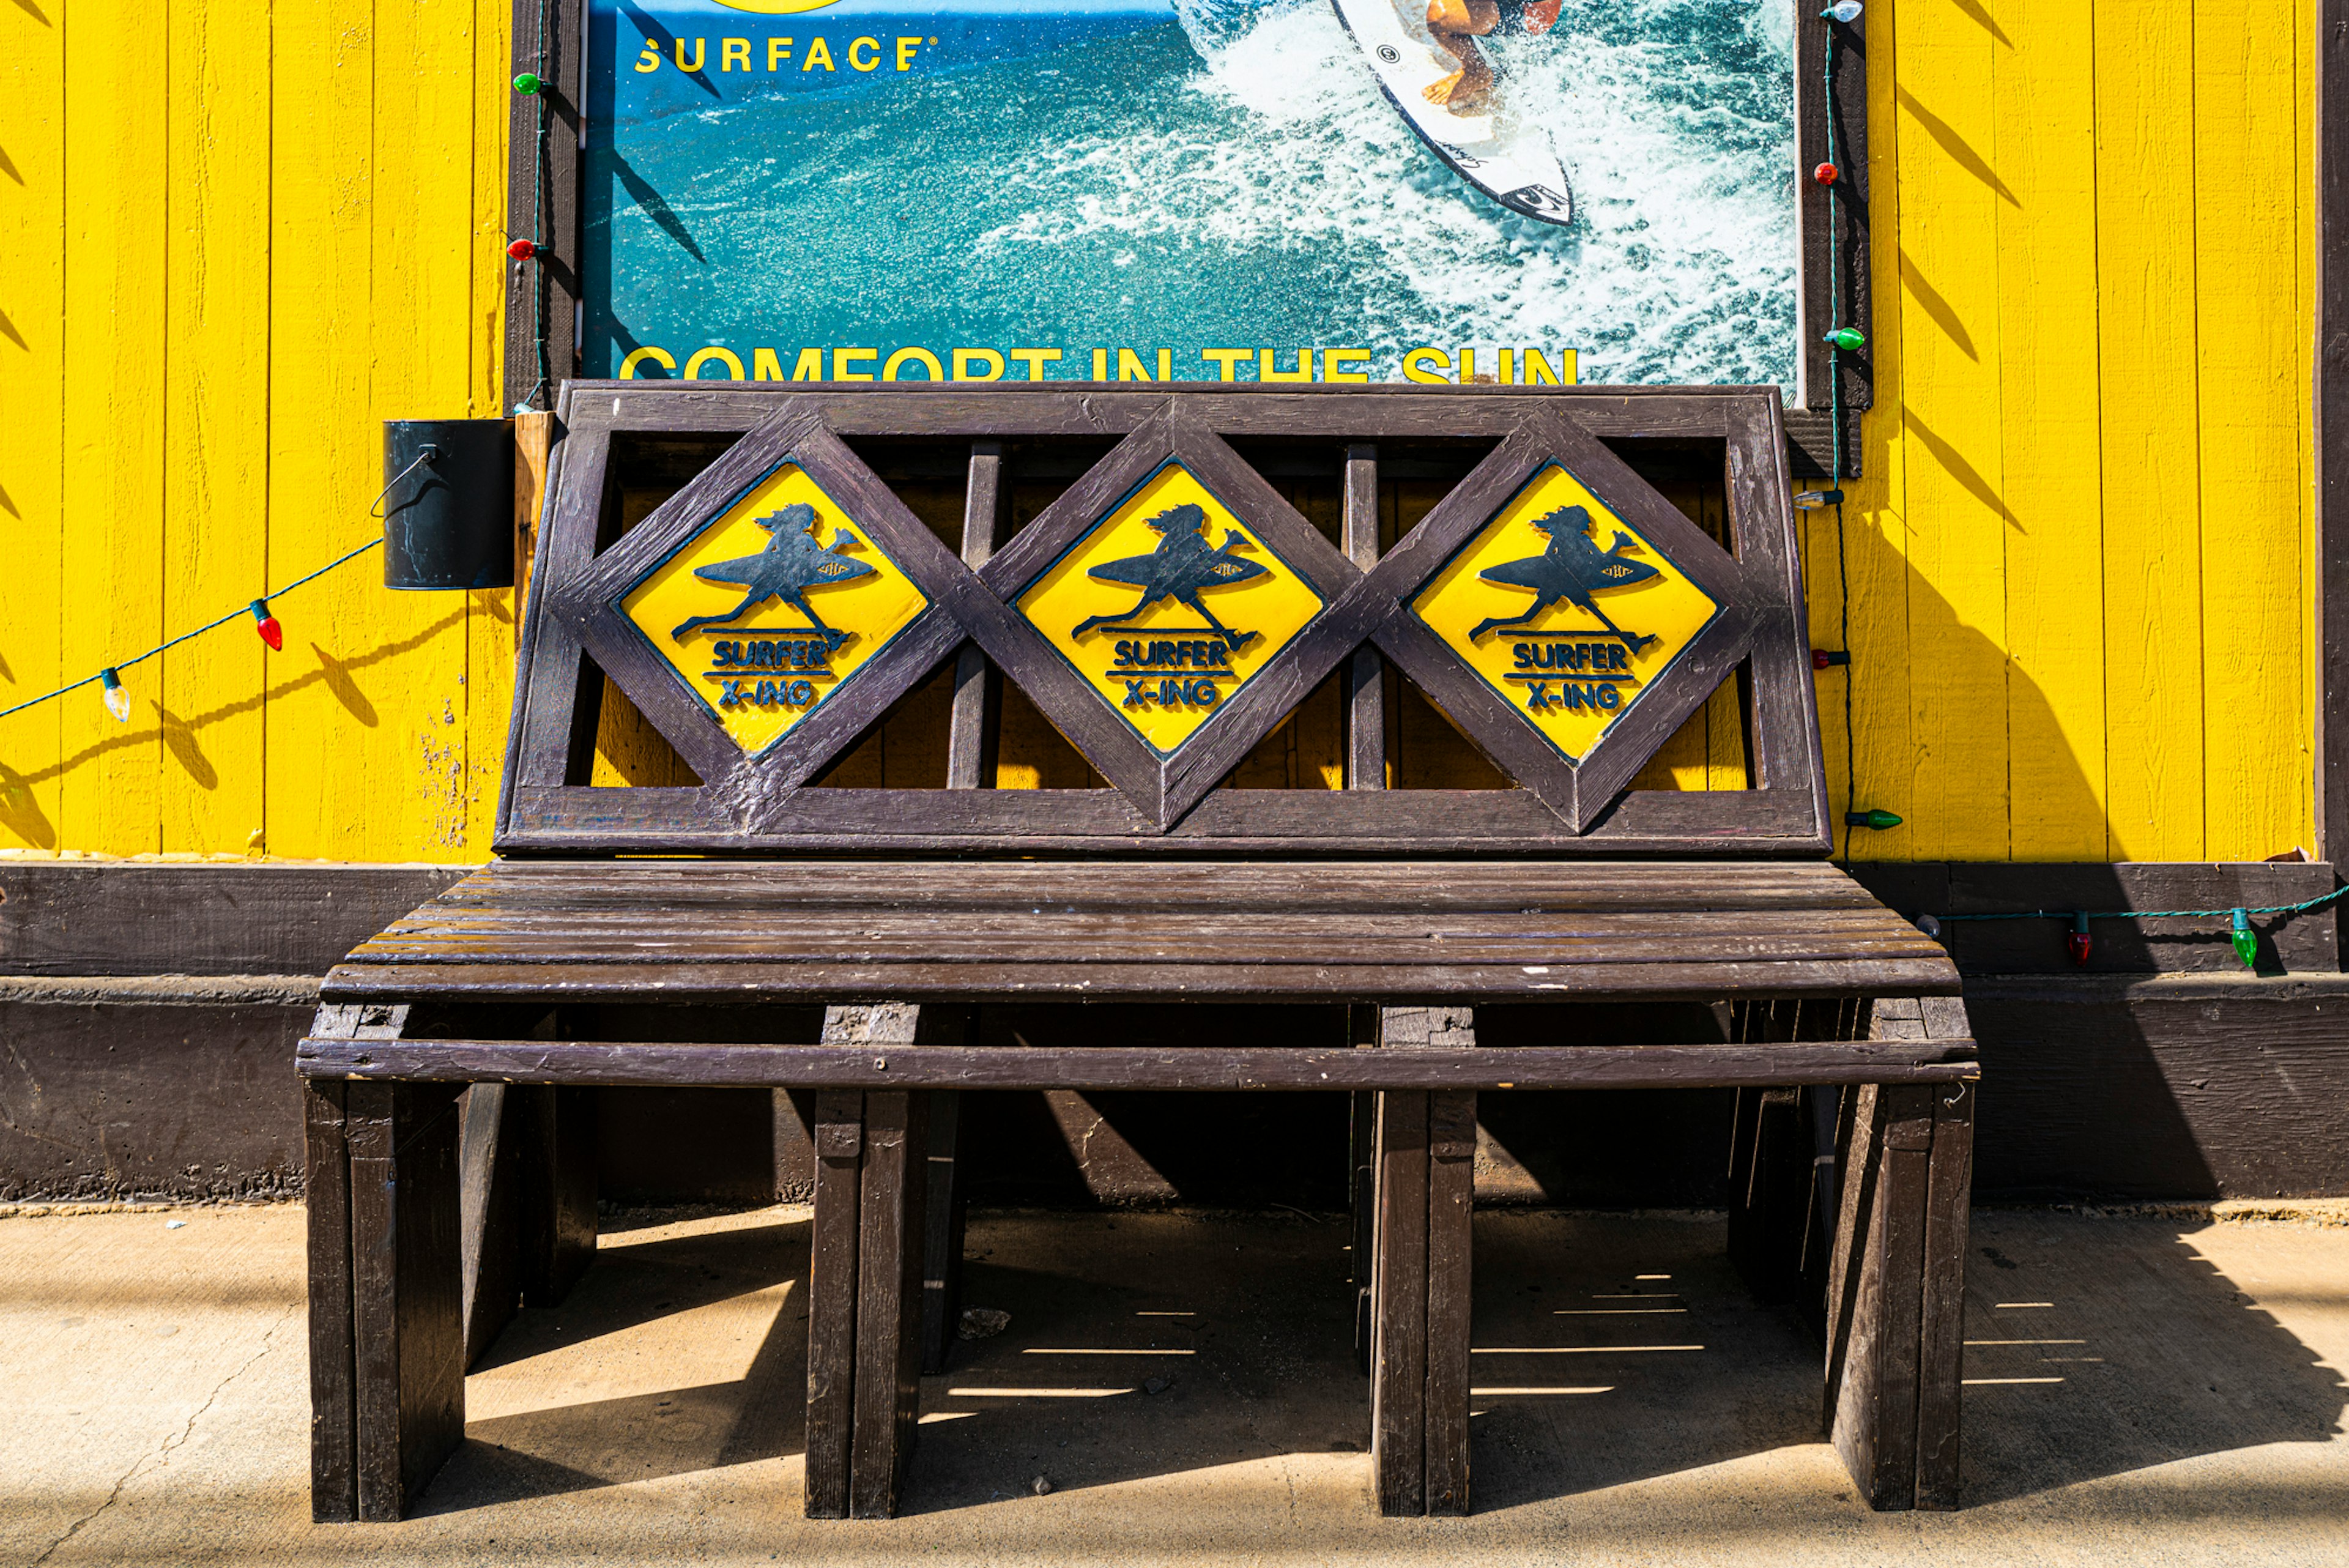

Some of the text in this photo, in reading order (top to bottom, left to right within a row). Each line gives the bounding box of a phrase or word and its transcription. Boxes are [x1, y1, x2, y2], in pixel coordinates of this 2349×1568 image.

[1092, 348, 1173, 381] IN
[1201, 348, 1371, 384] THE
[712, 640, 827, 666] SURFER
[1113, 640, 1228, 666] SURFER
[1513, 643, 1627, 670] SURFER
[718, 680, 812, 706] X-ING
[1123, 680, 1216, 706] X-ING
[1526, 682, 1619, 710] X-ING
